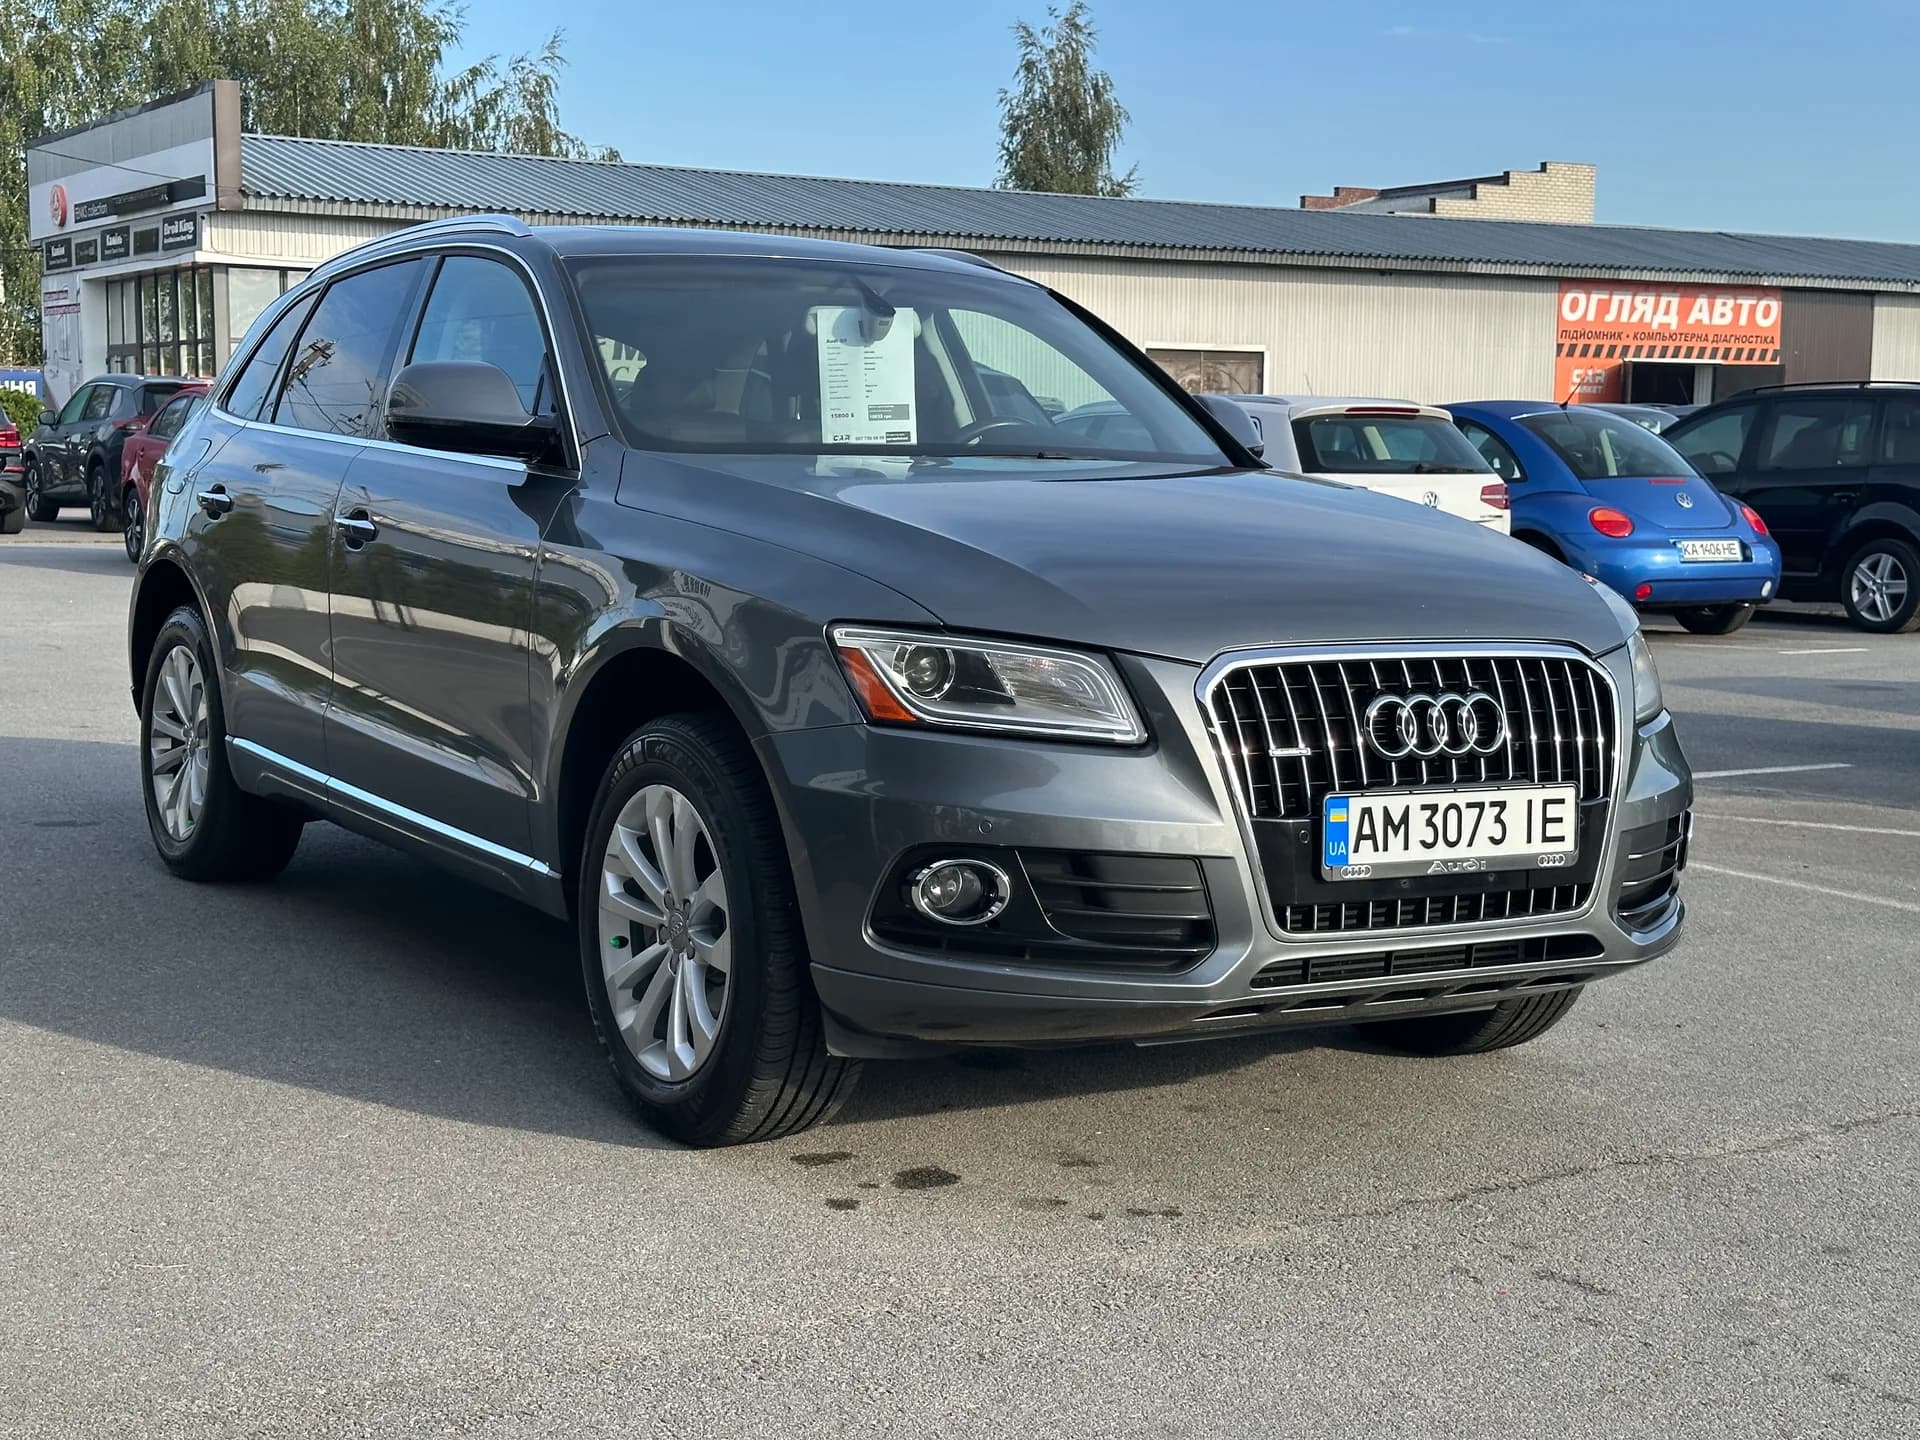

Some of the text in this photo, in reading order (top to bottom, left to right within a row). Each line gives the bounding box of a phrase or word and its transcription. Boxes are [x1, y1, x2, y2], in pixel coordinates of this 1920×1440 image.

[179, 218, 194, 233] King
[1561, 290, 1779, 329] ОГЛЯД АВТО
[1560, 329, 1775, 345] ПІДЙОМНИК КОМПЬЮТЕРНА ДІАГНОСТІКА
[1572, 368, 1605, 384] CAR
[1682, 543, 1737, 556] KA 1406 HE
[1352, 797, 1566, 854] AM 3073 IE
[1329, 842, 1346, 856] UA
[1427, 858, 1487, 874] Audi
